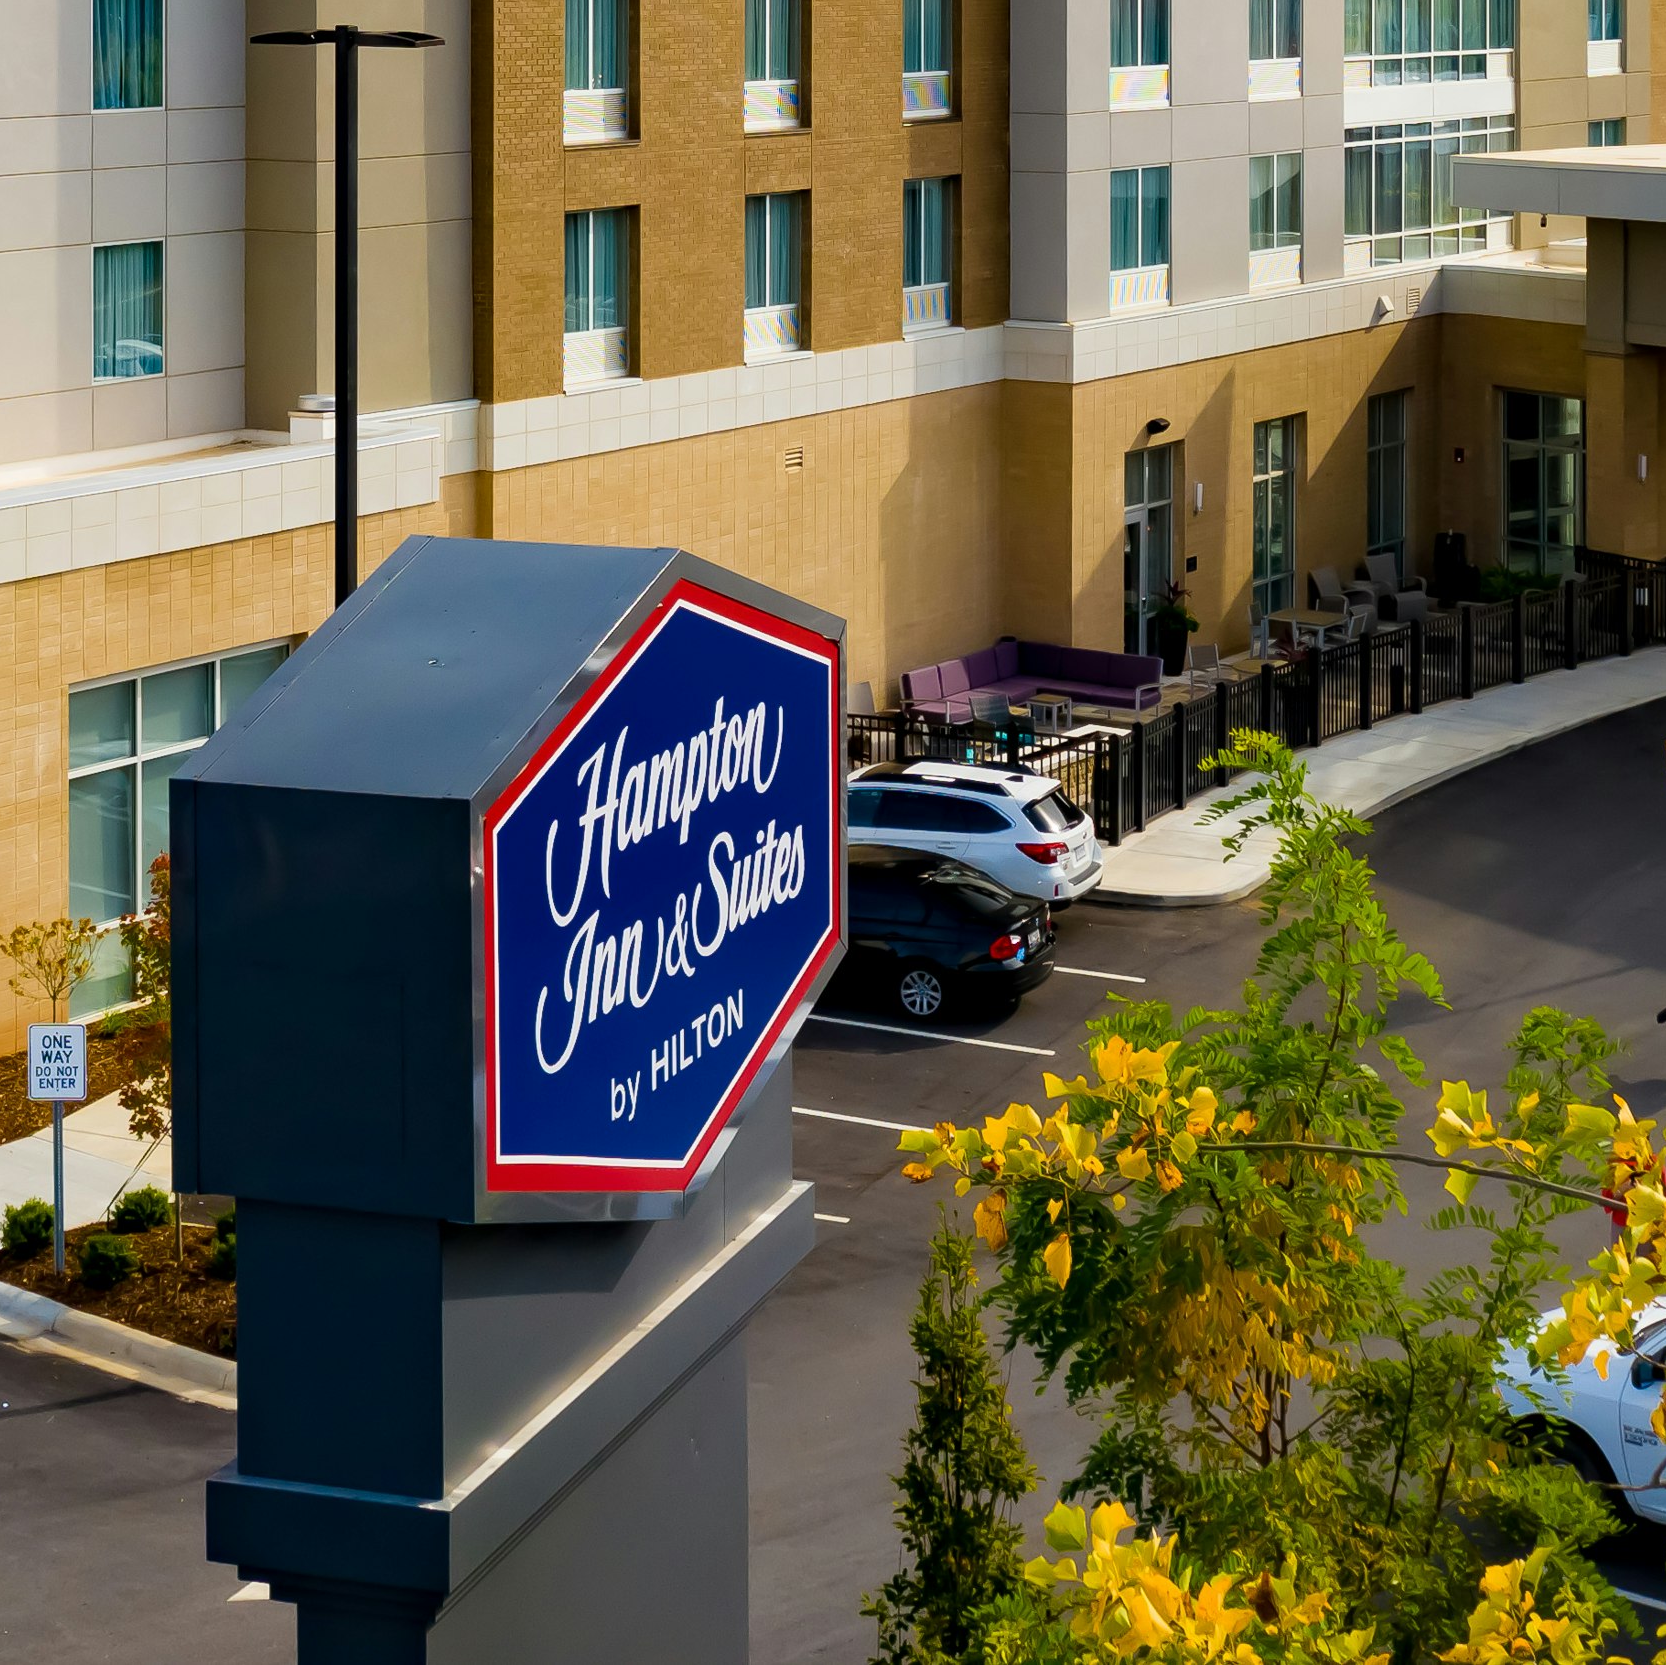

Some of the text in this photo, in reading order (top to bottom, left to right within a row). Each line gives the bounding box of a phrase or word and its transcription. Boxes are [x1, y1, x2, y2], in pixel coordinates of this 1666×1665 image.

[545, 695, 784, 928] Hampton
[535, 818, 805, 1074] Inn & Suites
[42, 1035, 72, 1049] ONE
[41, 1050, 73, 1064] WAY
[610, 988, 744, 1122] by HILTON
[35, 1065, 79, 1078] DO NOT
[39, 1078, 76, 1089] ENTER
